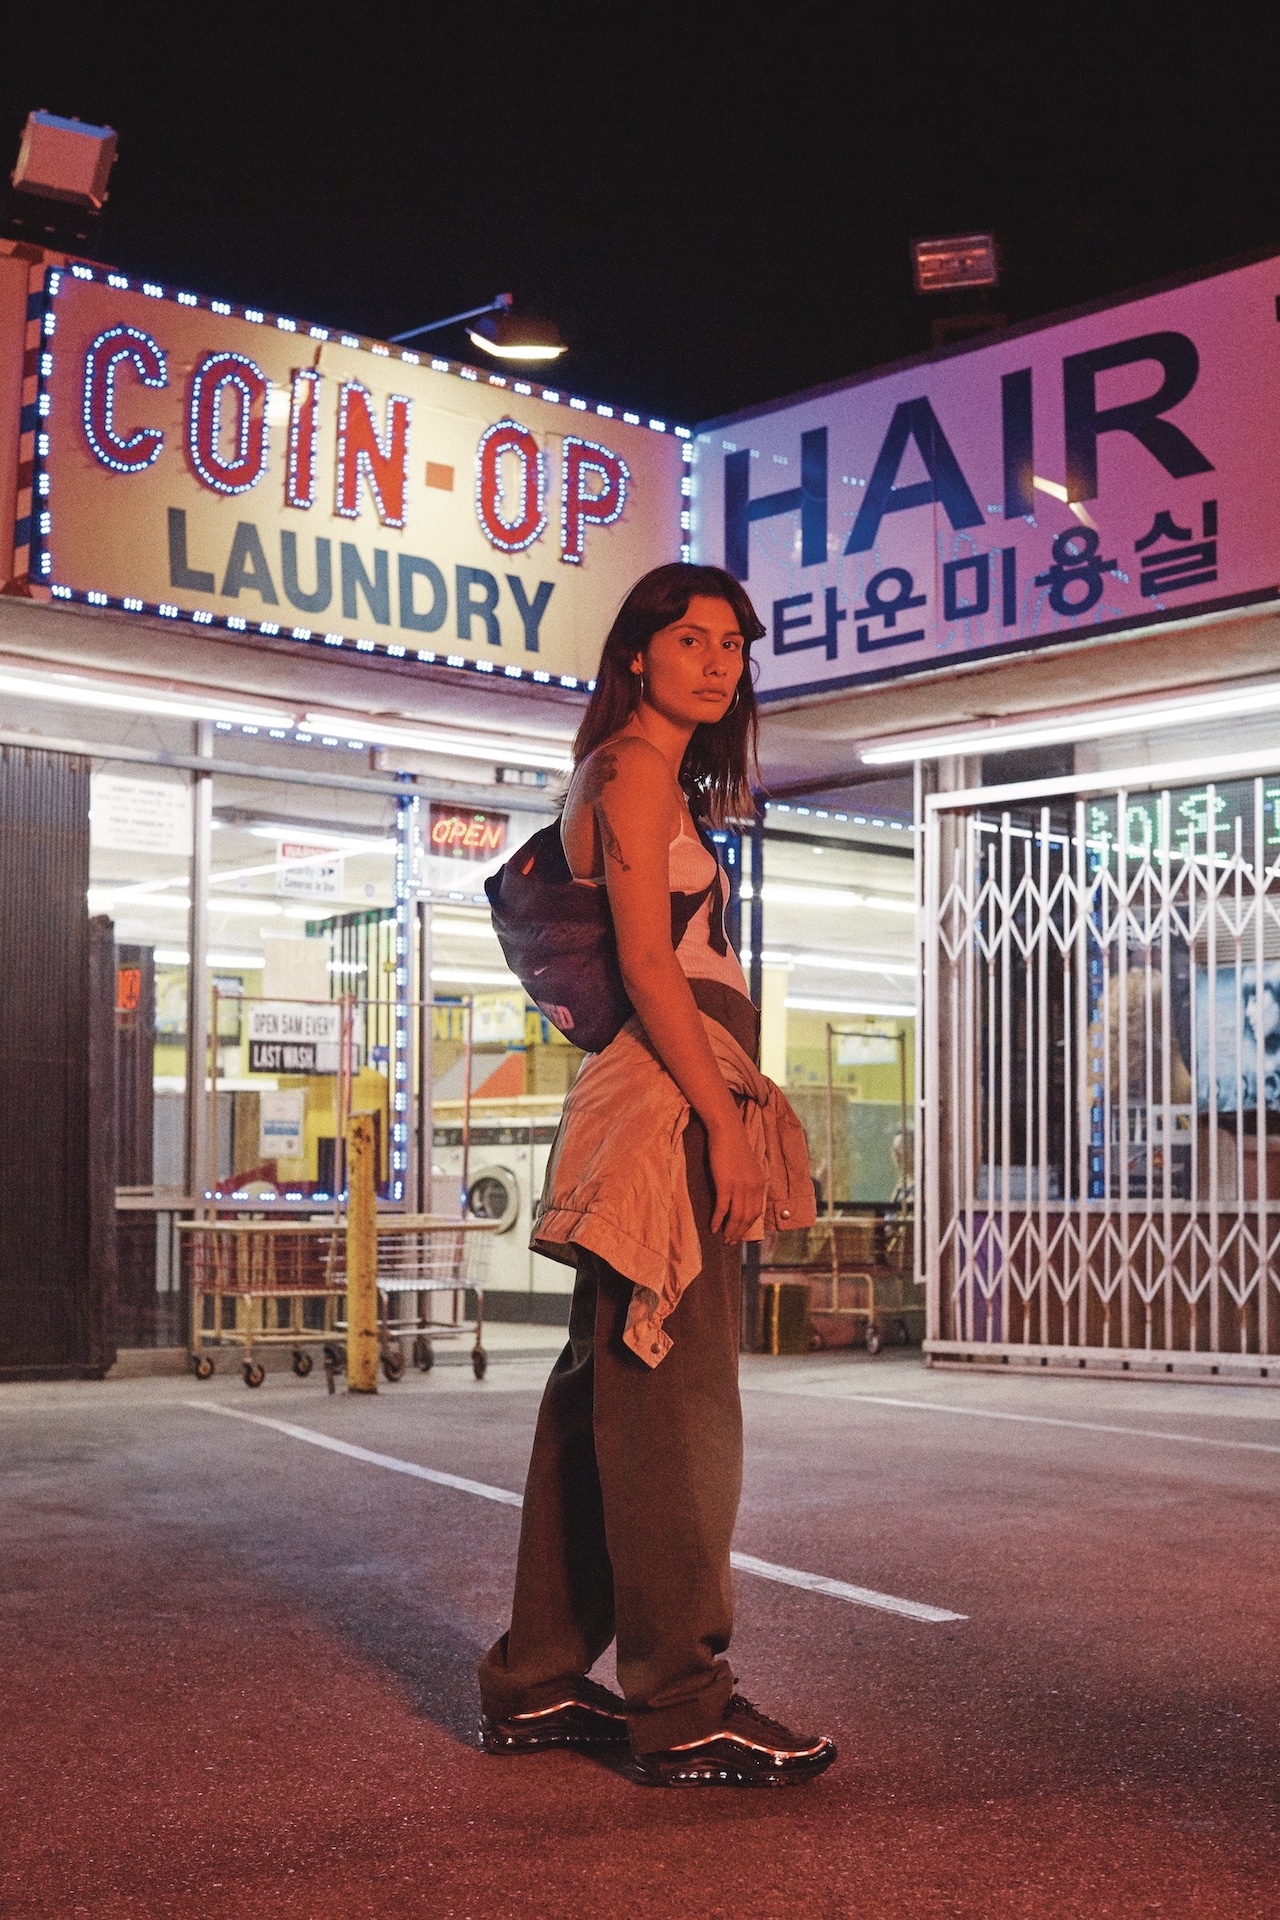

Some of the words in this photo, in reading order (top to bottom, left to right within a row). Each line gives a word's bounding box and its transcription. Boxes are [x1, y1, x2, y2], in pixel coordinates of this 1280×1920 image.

[83, 322, 631, 565] COIN-OP
[724, 330, 1216, 583] HAIR
[167, 506, 556, 653] LAUNDRY
[771, 499, 1219, 662] 타운미용실
[432, 819, 503, 849] OPEN
[253, 1013, 279, 1034] OPEN
[253, 1044, 282, 1069] LAST
[282, 1045, 315, 1069] WASH
